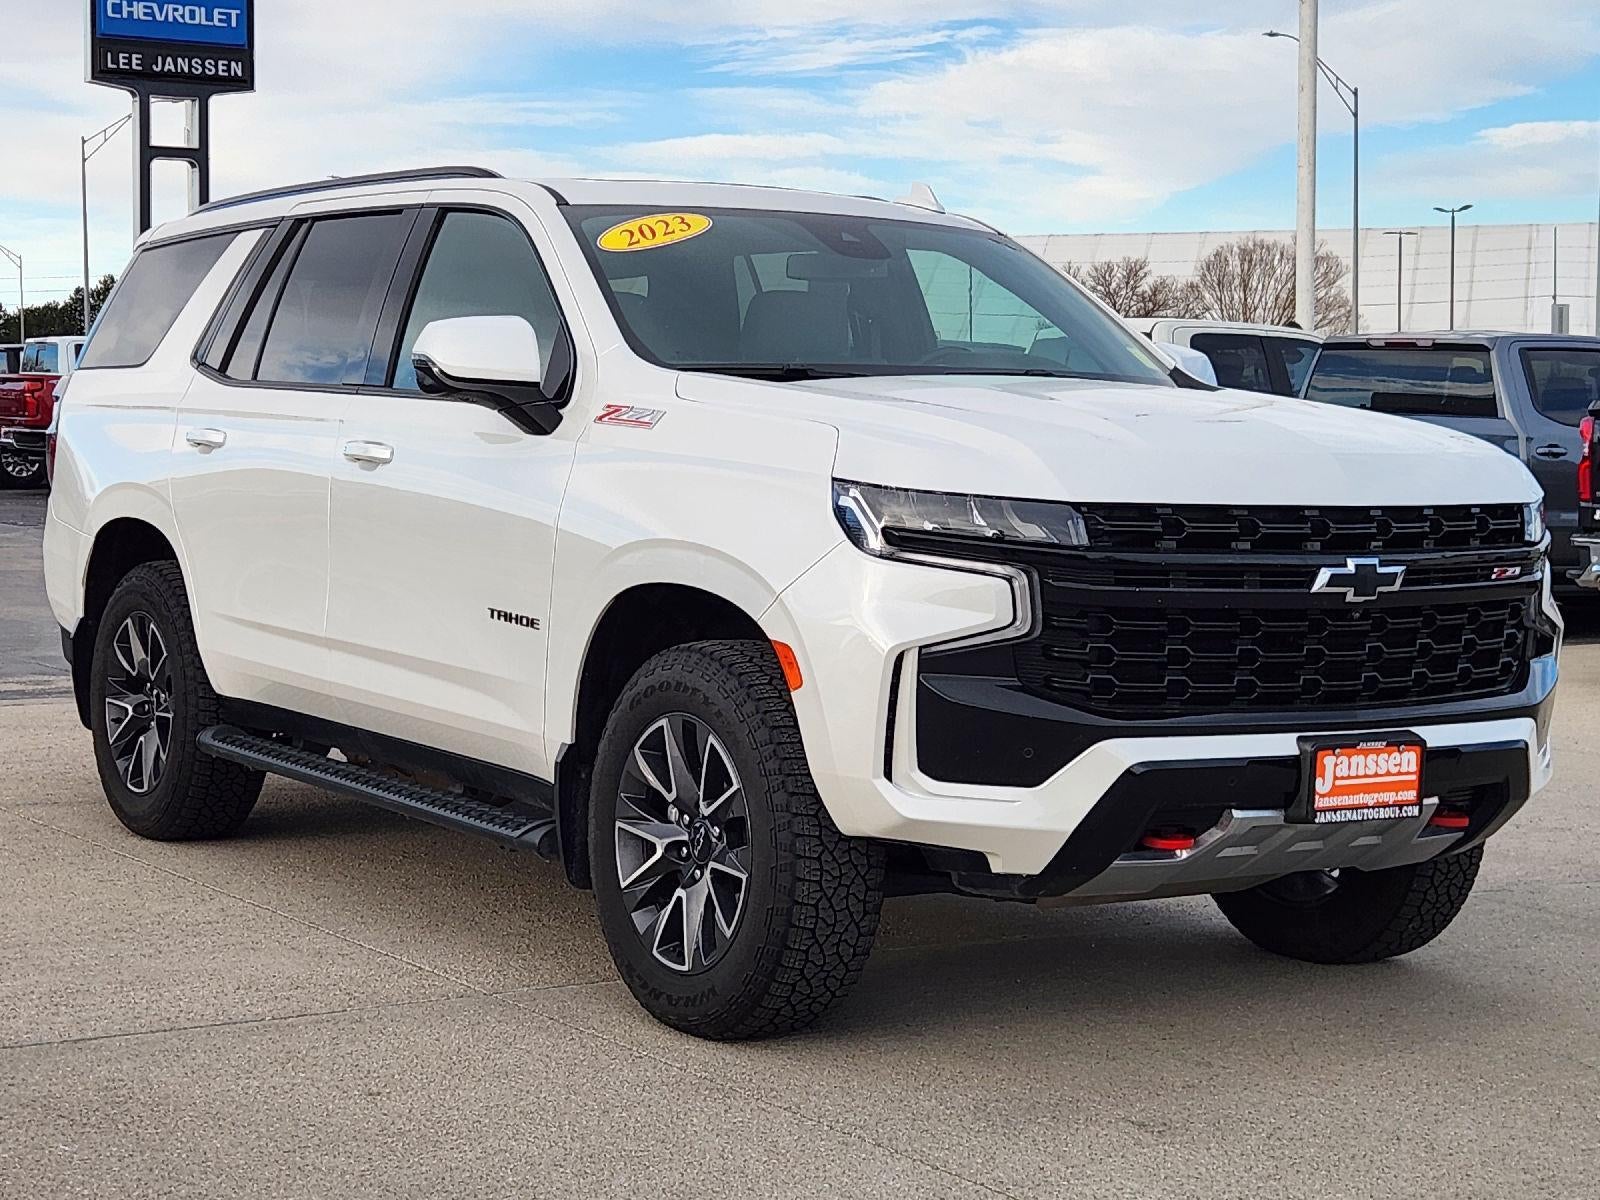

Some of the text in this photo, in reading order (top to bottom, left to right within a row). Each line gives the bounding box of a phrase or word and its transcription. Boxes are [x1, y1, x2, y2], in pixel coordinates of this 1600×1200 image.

[106, 0, 241, 28] CHEVROLET
[107, 51, 243, 77] LEE JANSSEN
[619, 215, 692, 248] 2023
[594, 404, 667, 430] Z71
[487, 606, 541, 631] TAHOE
[1315, 751, 1417, 794] Janssen
[1315, 790, 1417, 809] Janssenautogroup.com
[1315, 805, 1420, 823] JANSSENAUTOGROUP.COM
